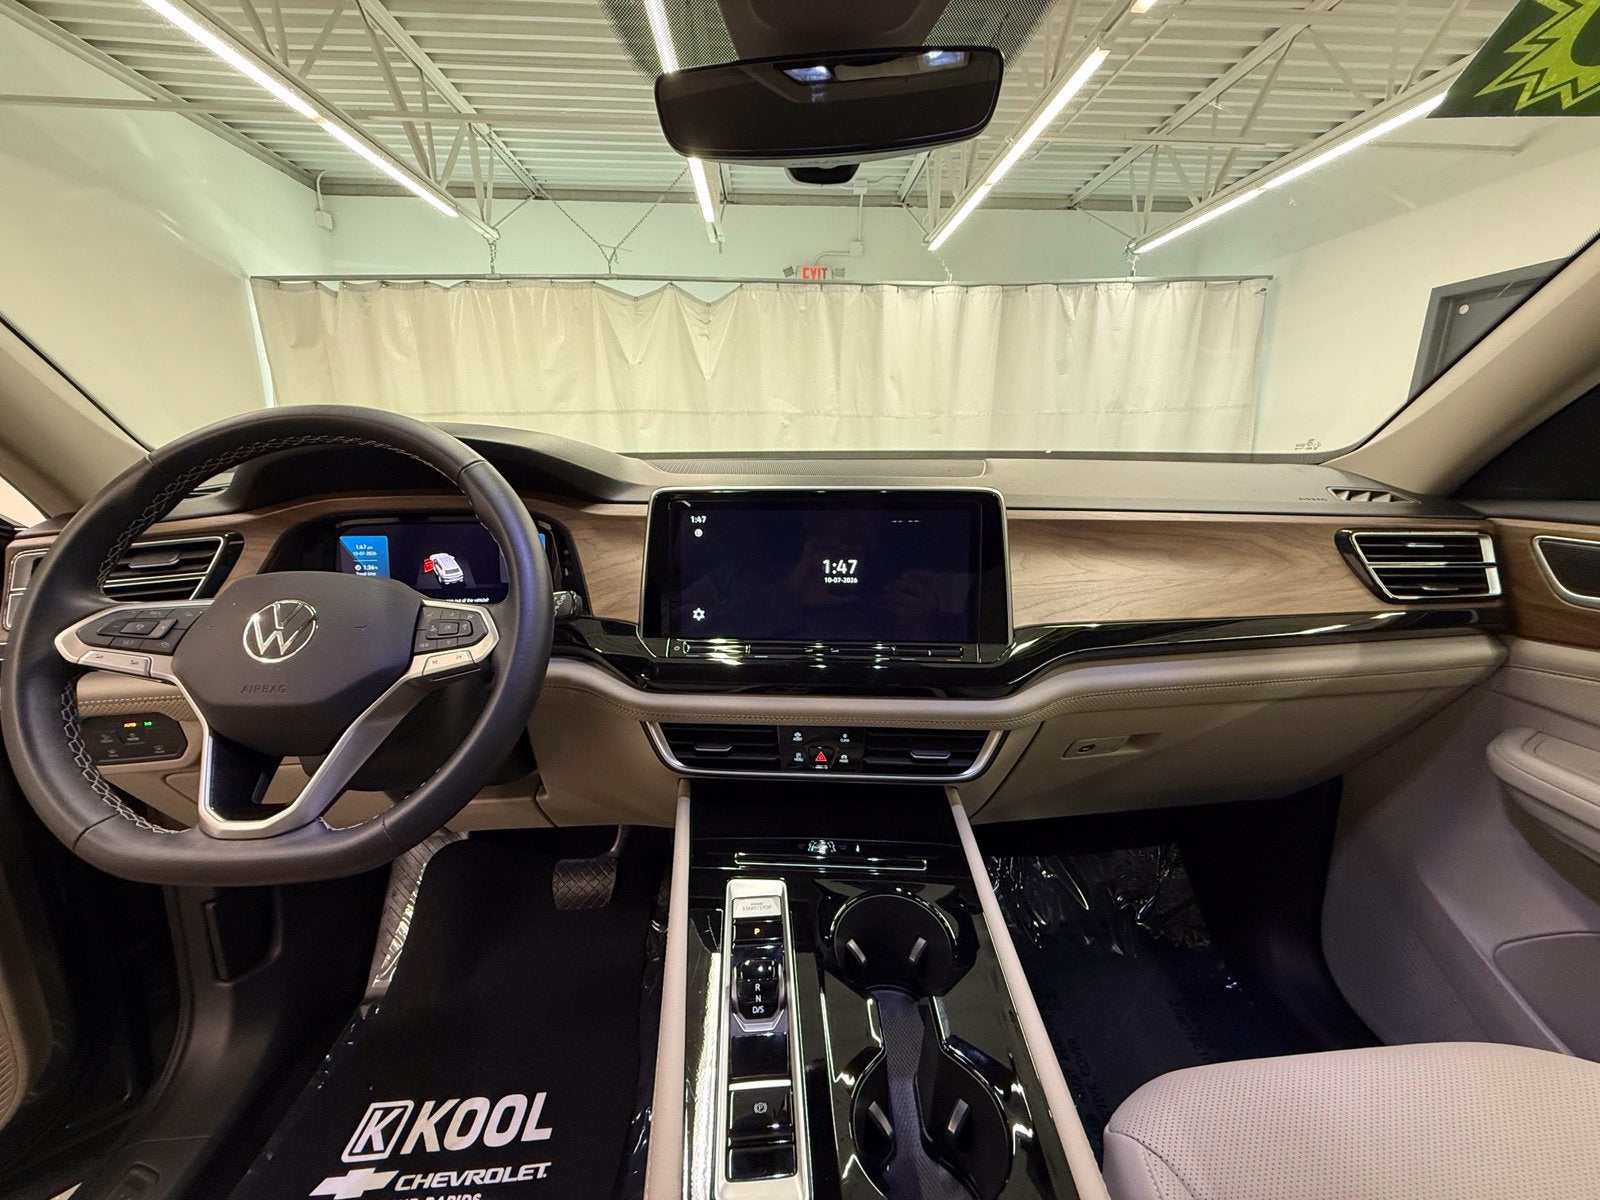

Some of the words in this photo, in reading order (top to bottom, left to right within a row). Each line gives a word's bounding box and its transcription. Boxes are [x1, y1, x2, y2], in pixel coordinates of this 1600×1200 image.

[690, 515, 707, 524] 1:47
[822, 559, 858, 575] 1:47
[823, 576, 859, 584] 10-07-2026
[240, 684, 287, 694] AIRBAG
[754, 927, 761, 936] P
[754, 983, 761, 992] R
[755, 994, 762, 1003] N
[751, 1005, 765, 1014] D/S
[400, 1092, 553, 1155] KOOL
[394, 1161, 552, 1192] CHEVROLET
